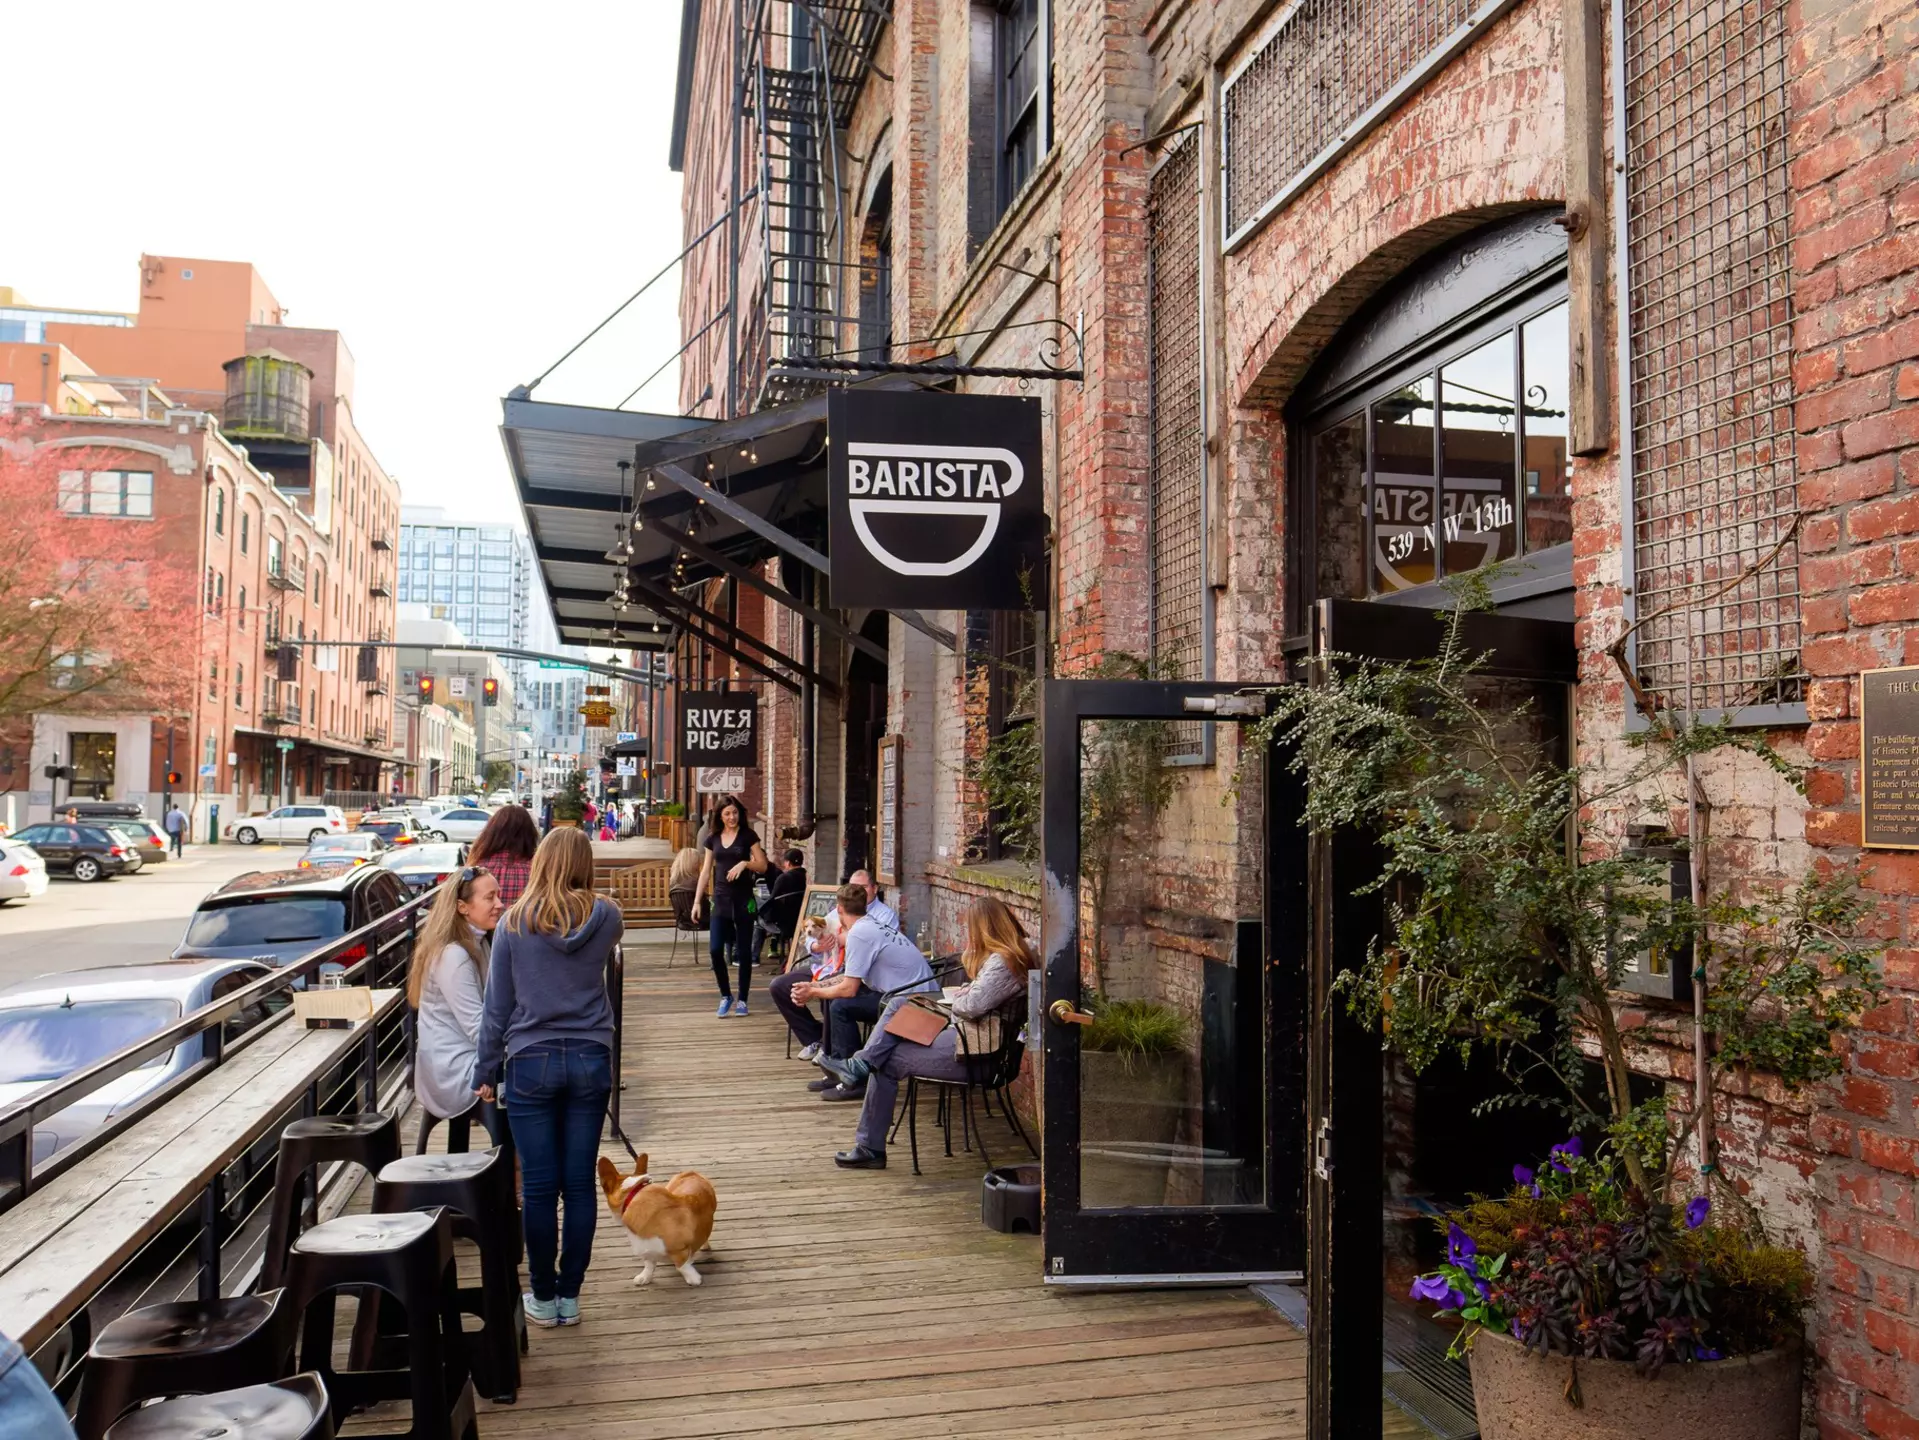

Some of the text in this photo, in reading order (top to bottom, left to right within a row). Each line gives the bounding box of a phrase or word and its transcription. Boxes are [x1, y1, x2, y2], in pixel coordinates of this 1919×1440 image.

[848, 459, 1000, 499] BARISTA
[1388, 531, 1414, 562] 539
[1475, 497, 1513, 535] 13th
[1887, 681, 1908, 693] THE
[687, 709, 751, 728] RIVER
[686, 731, 720, 750] PIG
[1872, 735, 1916, 746] This building
[1872, 746, 1881, 755] of
[1882, 746, 1908, 755] Historic
[1872, 758, 1910, 768] Department
[1893, 770, 1906, 779] part
[1872, 779, 1898, 788] Historic
[1872, 790, 1886, 799] Ben
[1891, 790, 1903, 799] and
[1873, 801, 1902, 810] furniture
[1873, 813, 1907, 822] warehouse
[1873, 824, 1918, 835] railroad spur
